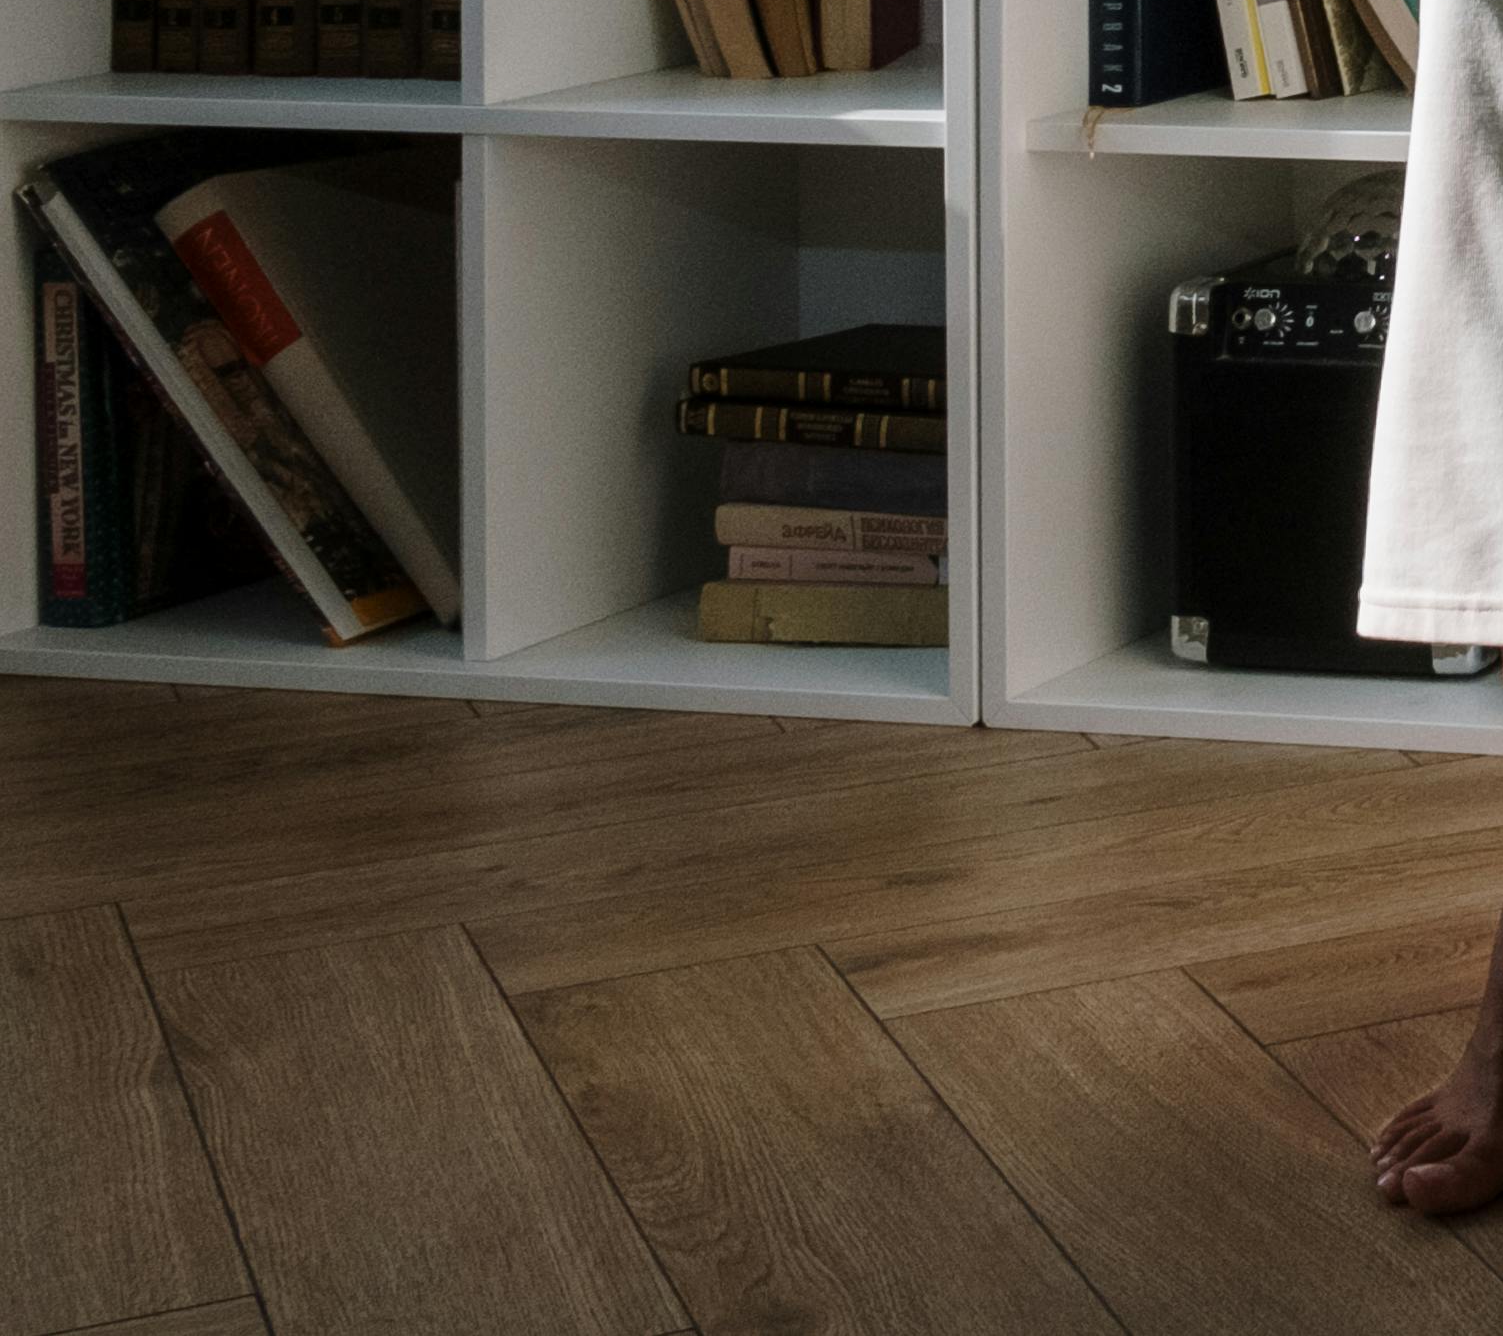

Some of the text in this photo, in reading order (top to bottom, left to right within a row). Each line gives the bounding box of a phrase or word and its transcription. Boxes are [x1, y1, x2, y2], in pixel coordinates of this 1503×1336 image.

[1101, 83, 1123, 94] 2
[55, 289, 77, 422] CHRISTMAS
[59, 443, 80, 488] NEW
[61, 491, 82, 557] YORK
